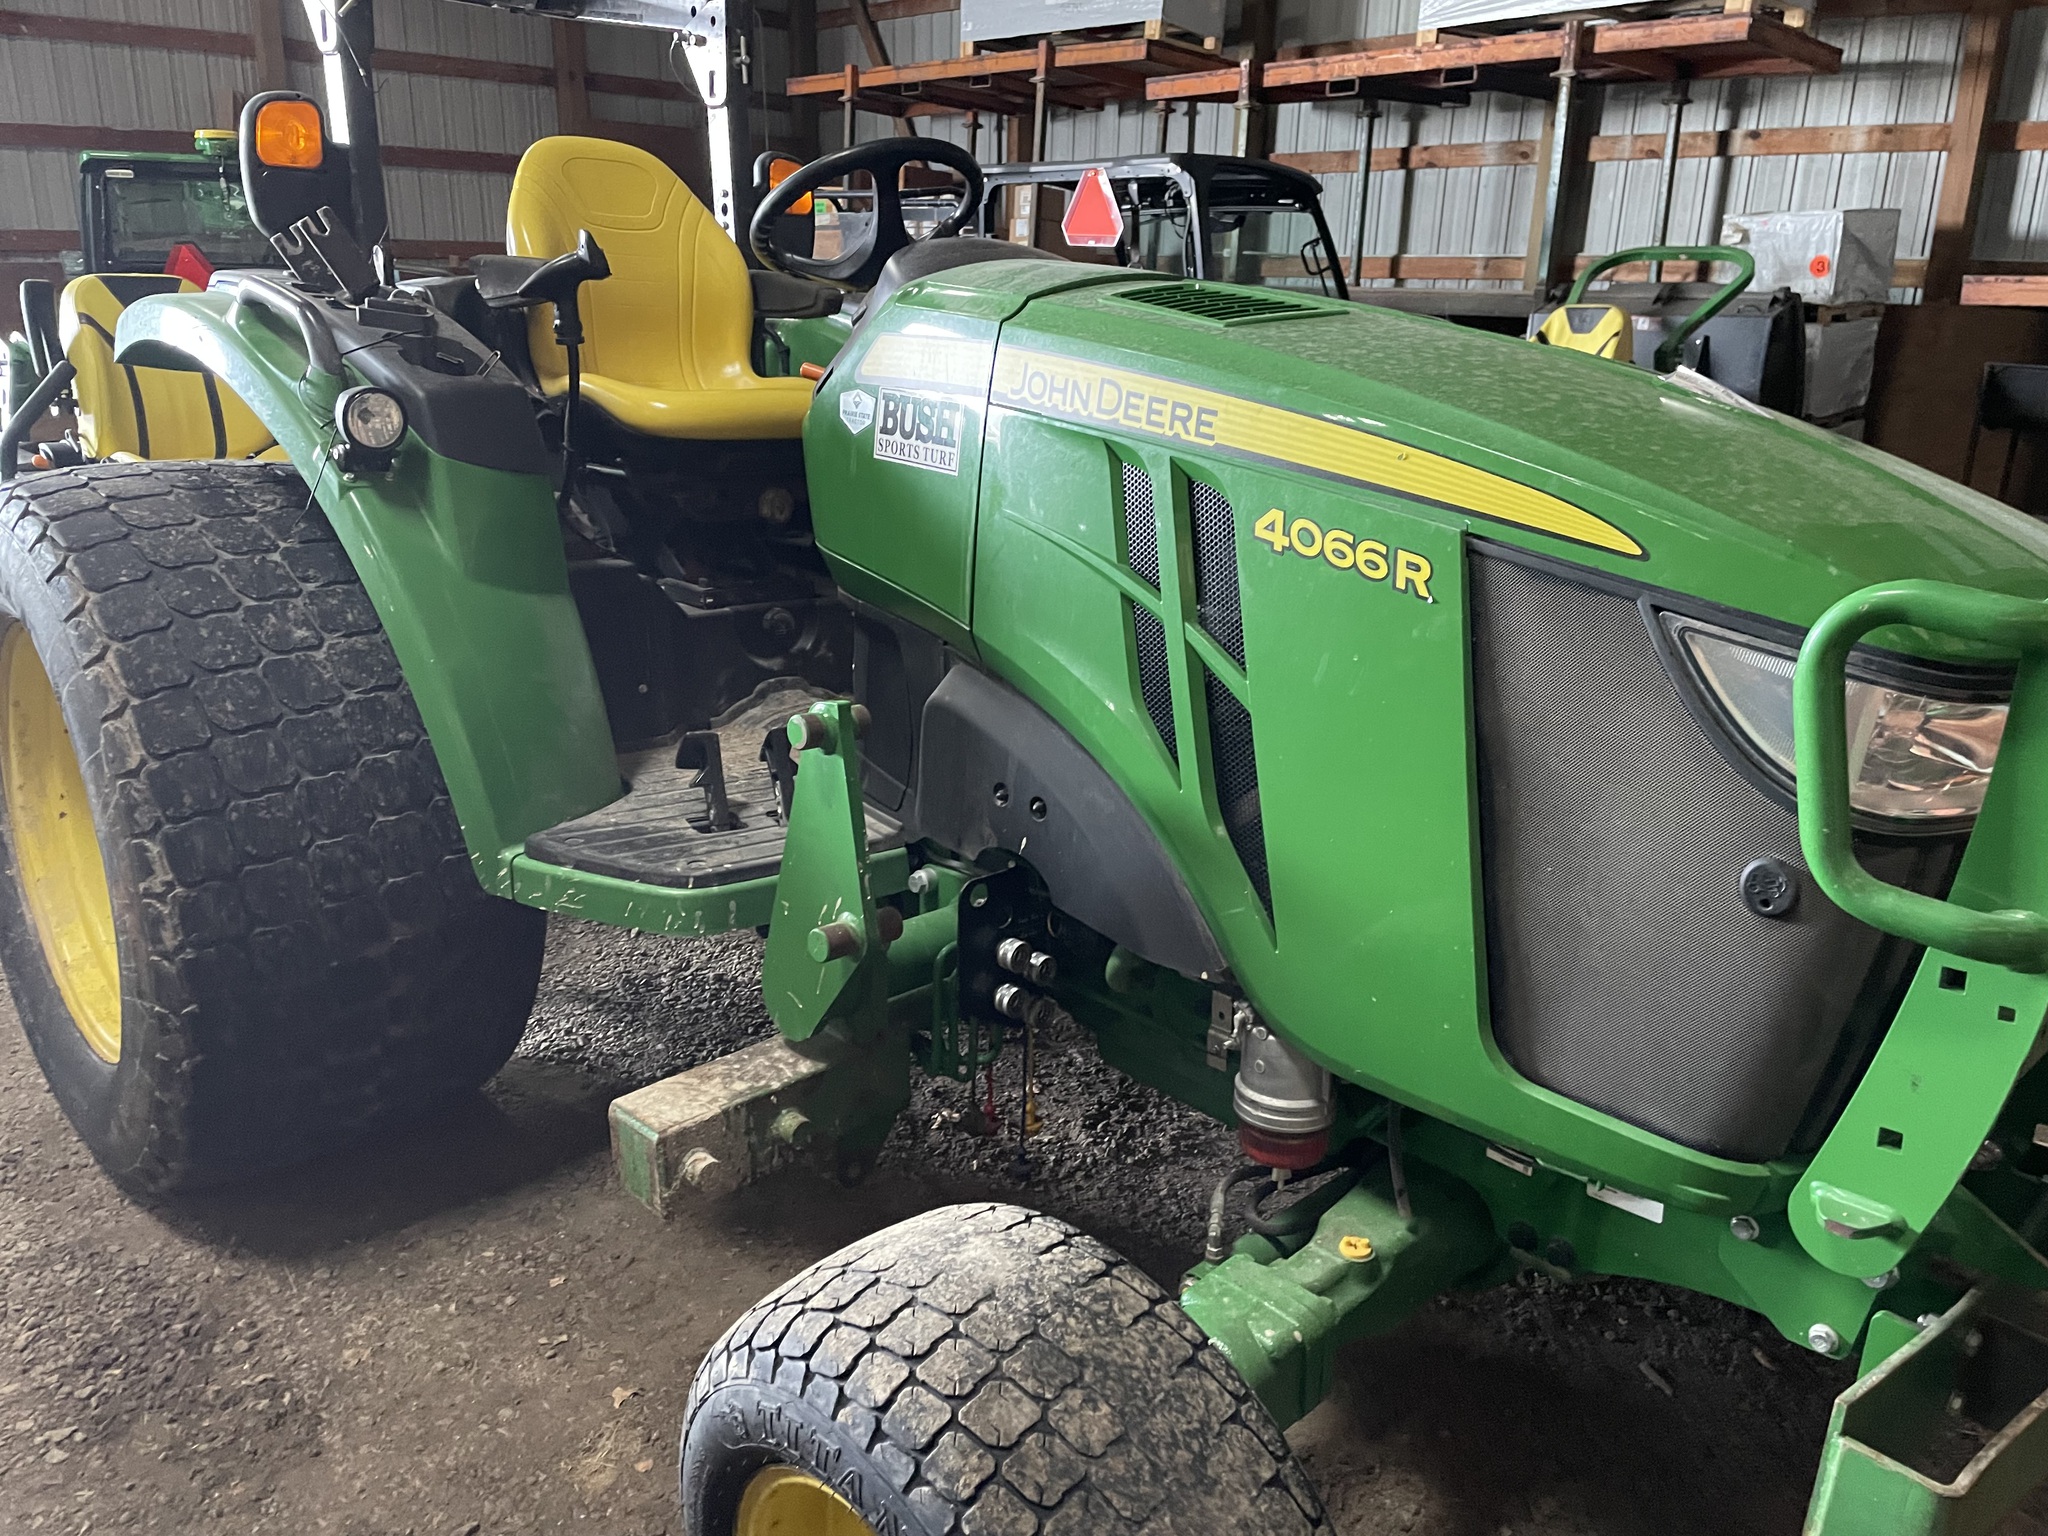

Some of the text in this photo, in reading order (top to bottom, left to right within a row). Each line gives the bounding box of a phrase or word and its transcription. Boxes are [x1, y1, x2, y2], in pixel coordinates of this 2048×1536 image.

[1816, 260, 1826, 274] 3
[879, 392, 960, 448] BUSH
[1010, 362, 1219, 442] JOHN DEERE
[878, 438, 956, 467] SPORTS TURF
[1254, 506, 1433, 600] 4066R
